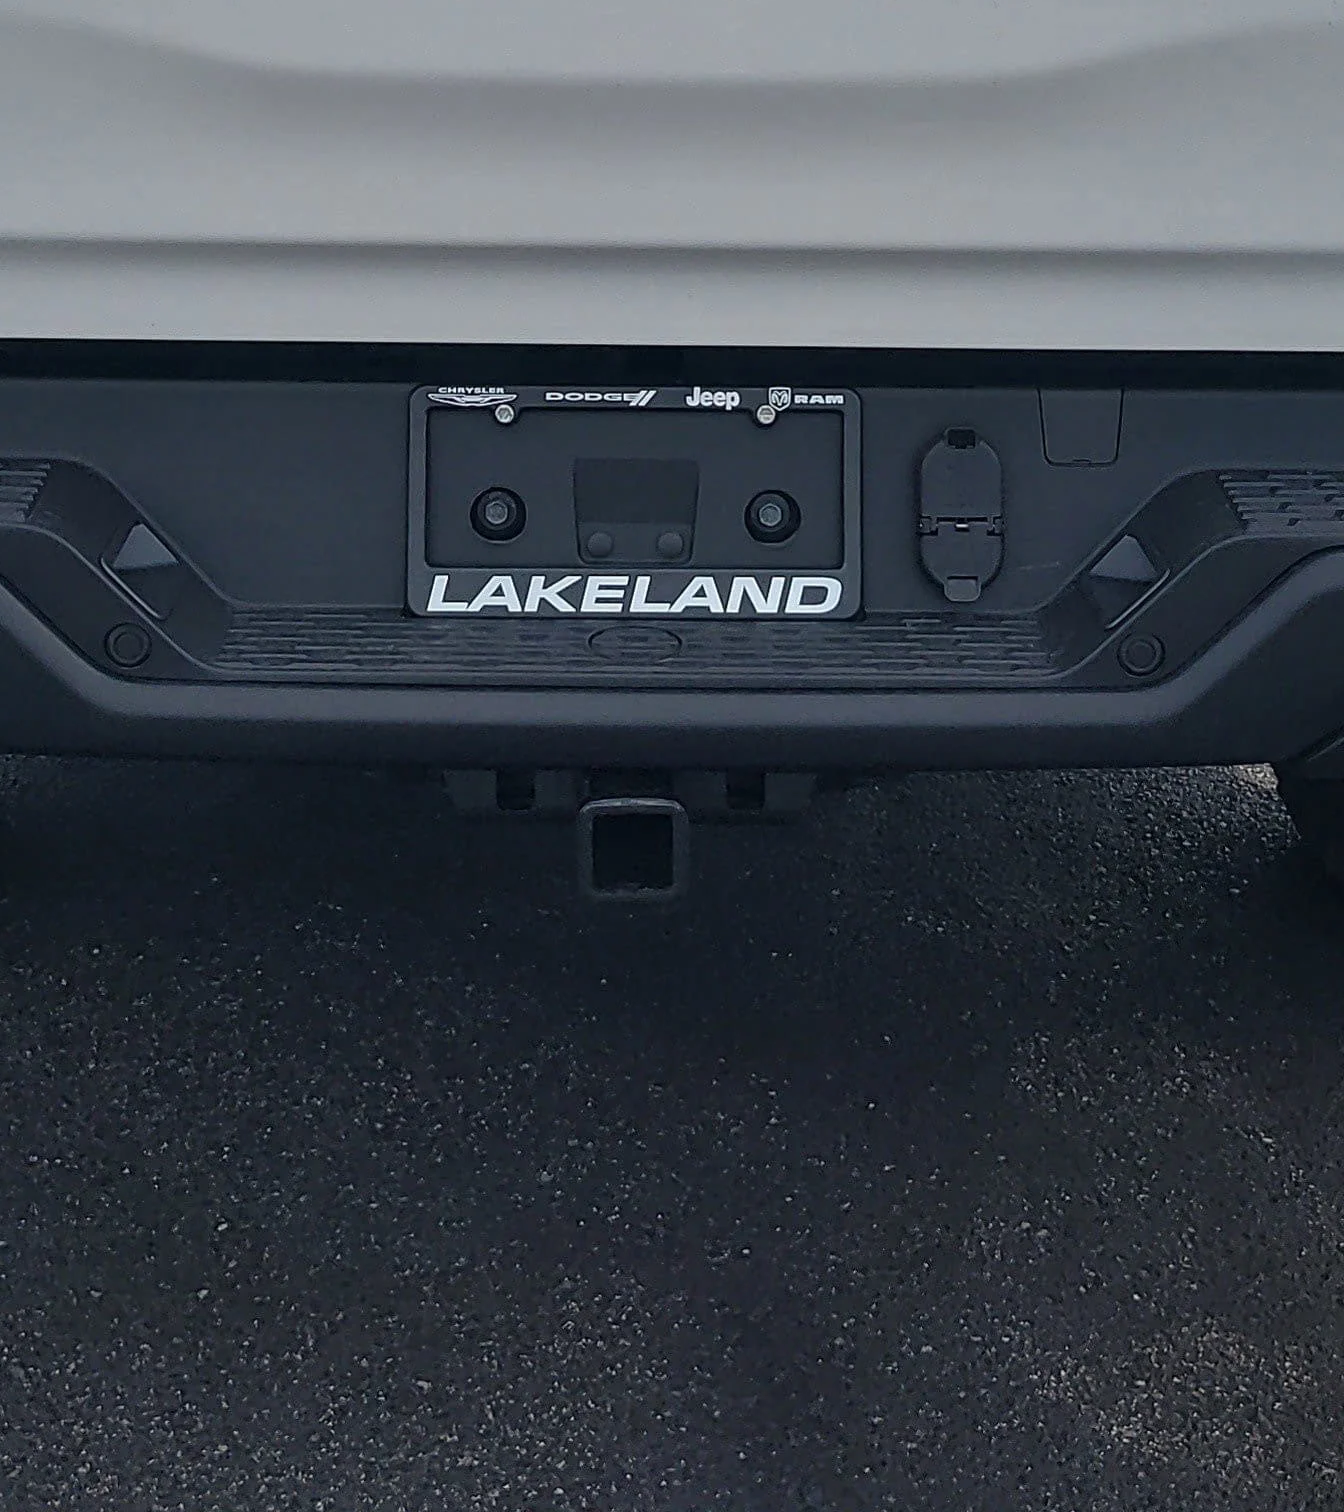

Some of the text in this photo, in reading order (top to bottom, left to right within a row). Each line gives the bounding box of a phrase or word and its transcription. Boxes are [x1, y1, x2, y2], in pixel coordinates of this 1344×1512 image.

[545, 392, 639, 402] DODGE
[686, 386, 740, 410] Jeep
[794, 394, 844, 404] RAM
[426, 574, 843, 614] LAKELAND
